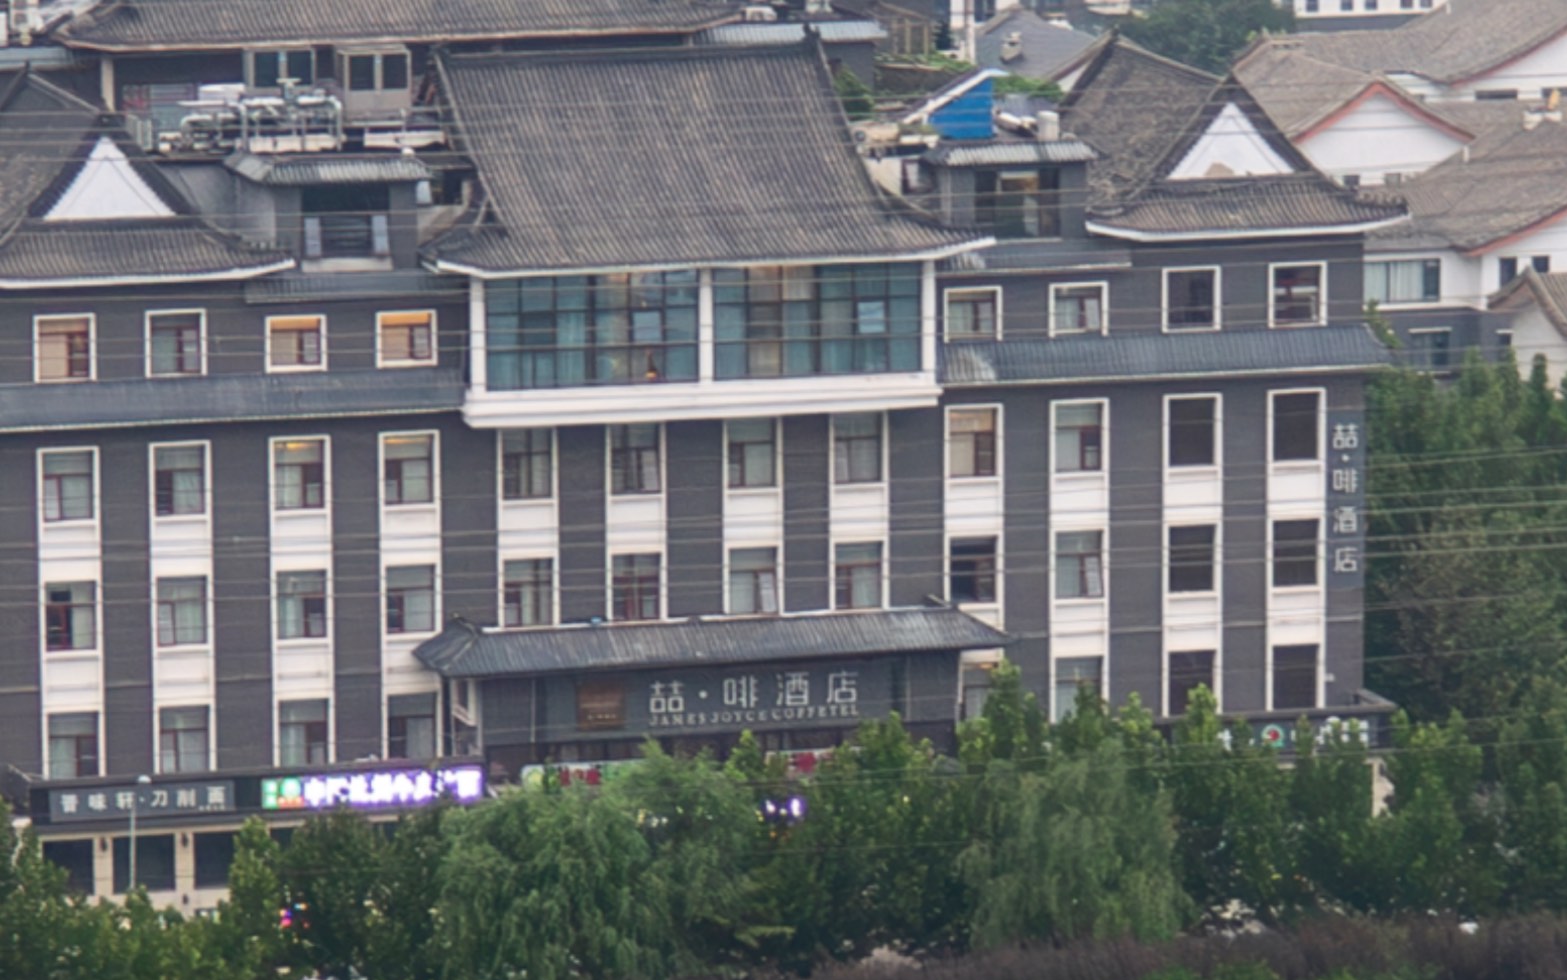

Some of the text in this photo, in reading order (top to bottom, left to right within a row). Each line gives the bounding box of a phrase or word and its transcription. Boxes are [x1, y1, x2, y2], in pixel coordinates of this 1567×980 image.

[1333, 423, 1359, 573] 喆·啡酒店
[649, 671, 859, 713] 喆·啡酒店
[649, 704, 859, 726] JAMES JOYCE COFFETEL
